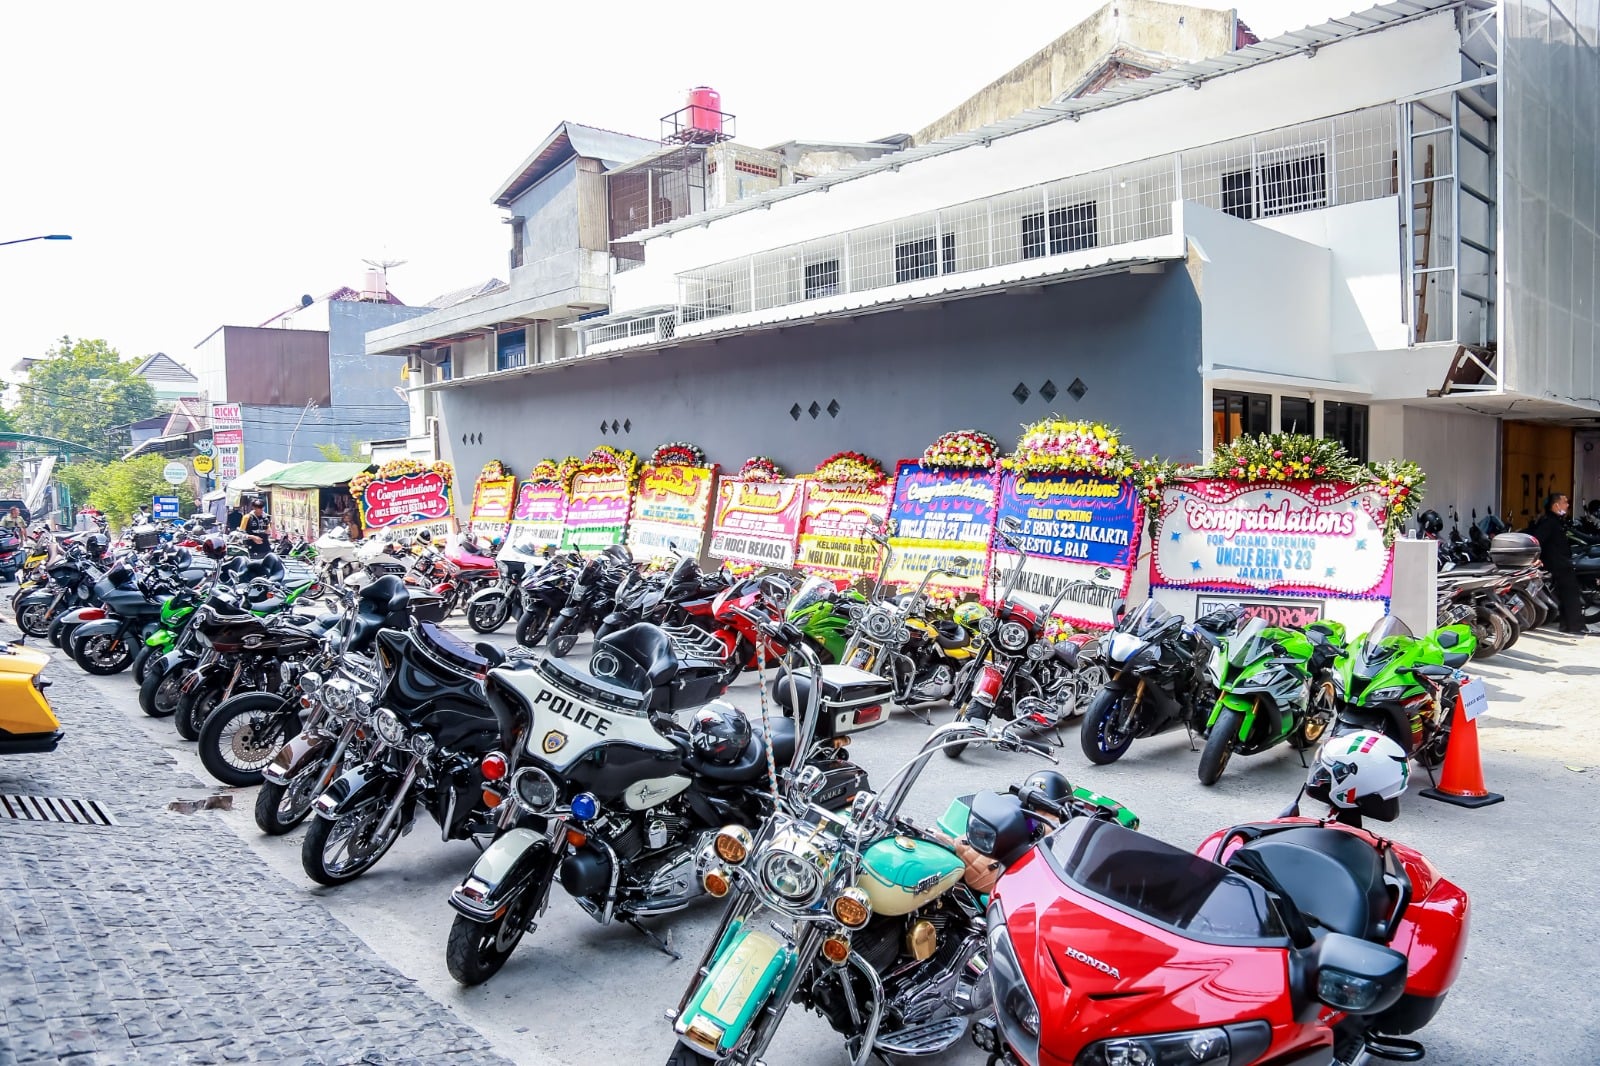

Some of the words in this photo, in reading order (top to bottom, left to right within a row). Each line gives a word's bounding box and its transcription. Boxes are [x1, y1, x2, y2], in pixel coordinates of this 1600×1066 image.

[214, 407, 239, 417] RICKY
[377, 484, 437, 503] Congratulations
[809, 484, 888, 506] Congratulations
[1016, 478, 1119, 499] Congratulations
[1028, 508, 1053, 519] GRAND
[1055, 509, 1093, 522] OPENING
[1185, 499, 1354, 539] Congratulations
[899, 519, 925, 538] UNCLE
[945, 522, 959, 540] 23
[959, 523, 991, 543] JAKAR
[999, 518, 1030, 534] ULE
[1032, 520, 1059, 538] BEN'S
[1060, 523, 1076, 538] 23
[1075, 525, 1129, 546] JAKARTA
[724, 537, 747, 554] HDCI
[747, 540, 786, 560] BEKASI
[816, 540, 852, 552] KELUARGA
[853, 543, 876, 555] BESAR
[1053, 540, 1063, 554] &
[1064, 542, 1089, 559] BAR
[1207, 535, 1225, 547] FOR
[1235, 535, 1268, 547] GRAND
[1271, 537, 1316, 550] OPENING
[807, 550, 824, 564] MBI
[824, 551, 840, 566] DKI
[841, 553, 878, 570] JAKART
[903, 553, 930, 570] POLICE
[1216, 547, 1255, 566] UNCLE
[1295, 551, 1313, 570] 23
[1236, 568, 1284, 580] JAKARTA
[1031, 573, 1054, 597] ELANG
[1278, 606, 1319, 628] ROW
[534, 690, 612, 738] POLICE
[1064, 946, 1121, 980] HONDA
